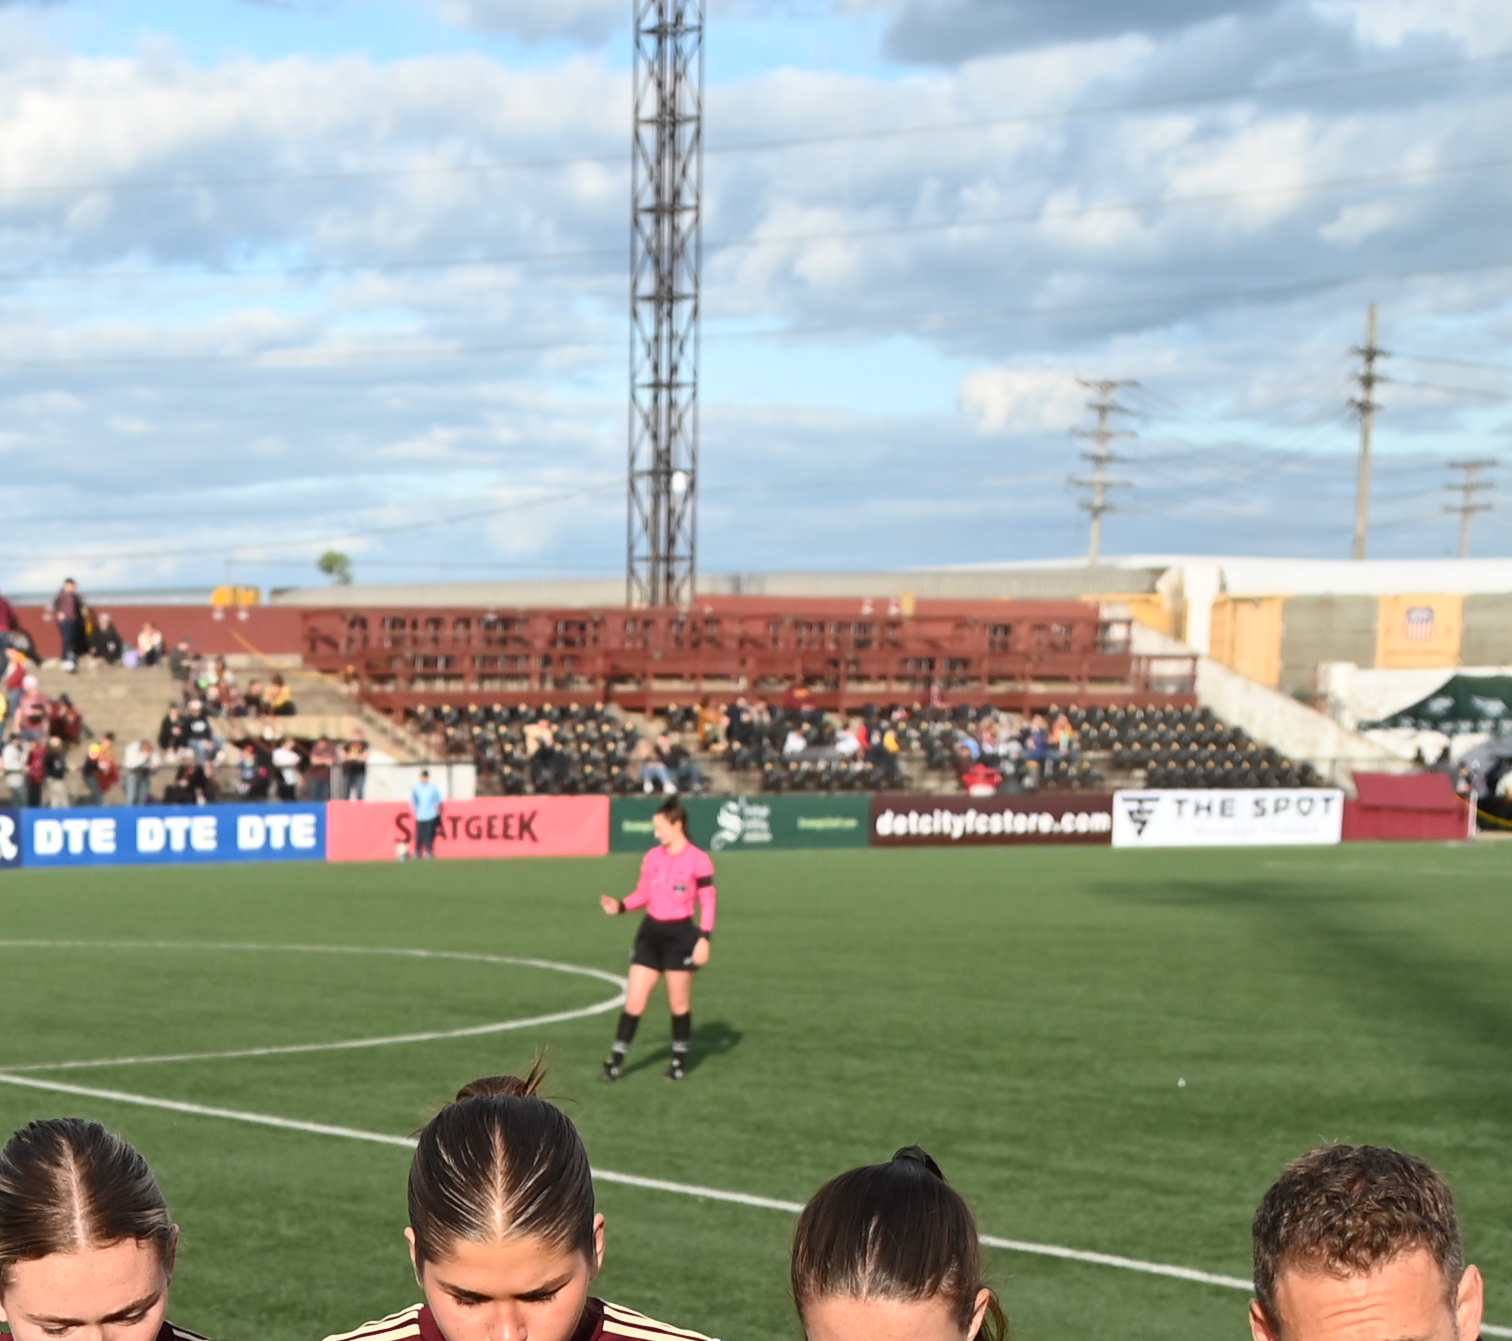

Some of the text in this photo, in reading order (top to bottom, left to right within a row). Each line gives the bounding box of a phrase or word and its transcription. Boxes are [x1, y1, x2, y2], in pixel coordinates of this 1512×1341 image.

[875, 808, 1112, 839] detcityfcstore.com
[1174, 796, 1335, 818] THE SPOT
[33, 813, 316, 855] DTE DTE DTE
[395, 810, 539, 845] SATGEEK
